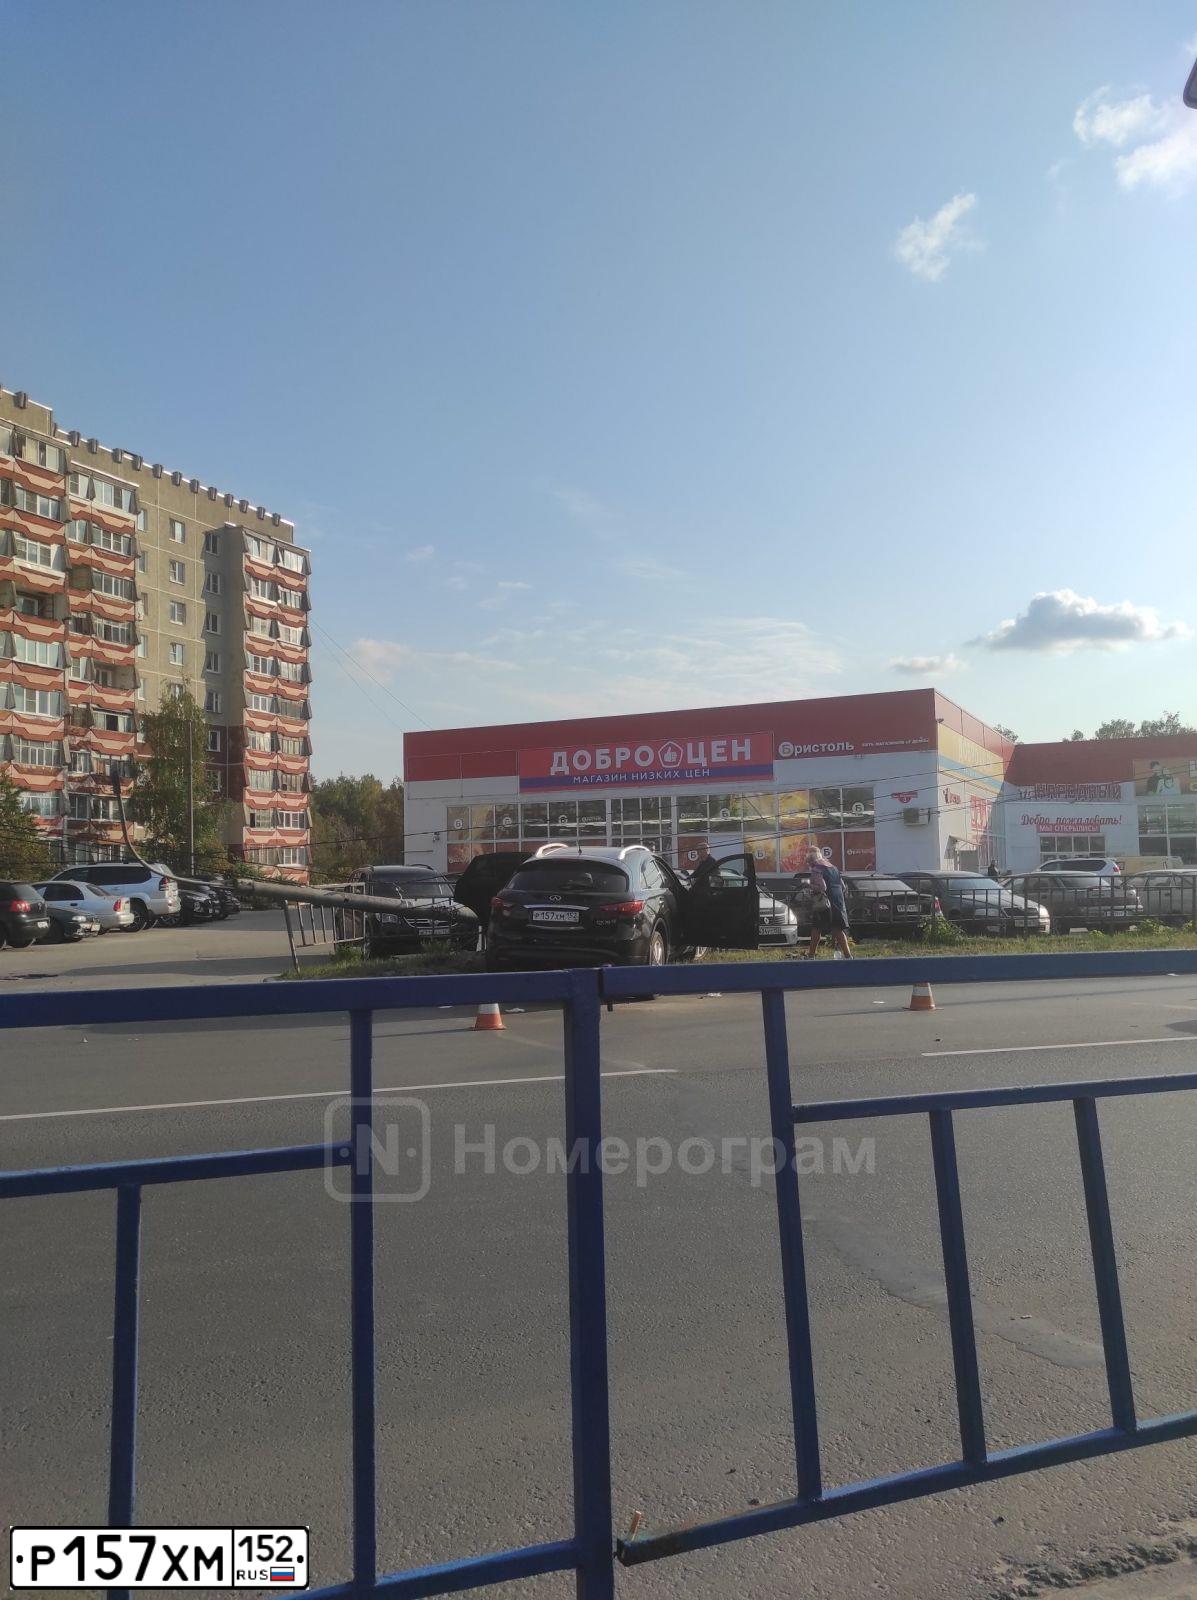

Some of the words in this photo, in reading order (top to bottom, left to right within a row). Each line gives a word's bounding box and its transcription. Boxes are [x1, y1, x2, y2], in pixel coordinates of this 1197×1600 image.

[550, 745, 655, 775] ДОБРО
[687, 738, 750, 767] ЦЕН
[778, 741, 855, 758] Бристоль
[573, 773, 627, 784] МАГАЗИН
[631, 771, 680, 781] НИЗКИХ
[685, 768, 710, 779] ЦЕН
[1039, 824, 1052, 832] МЫ
